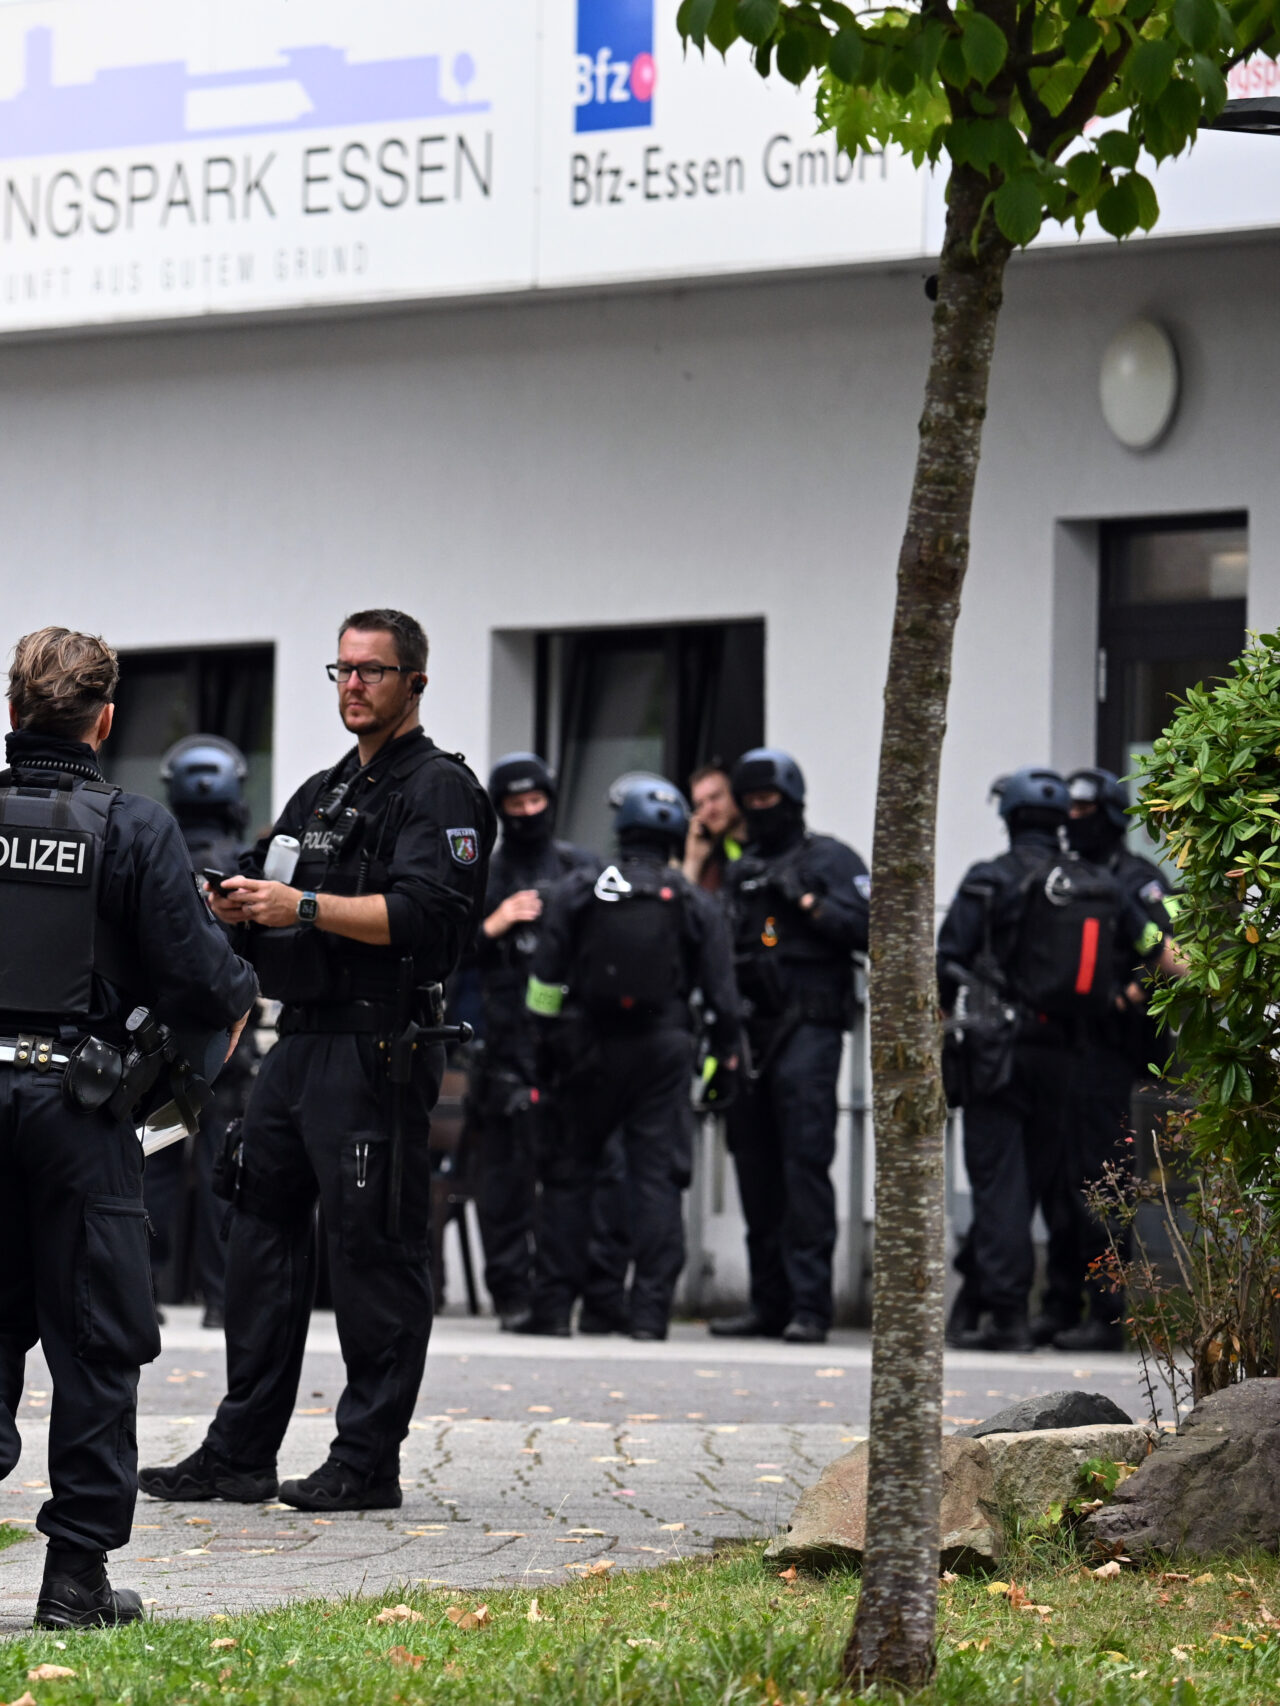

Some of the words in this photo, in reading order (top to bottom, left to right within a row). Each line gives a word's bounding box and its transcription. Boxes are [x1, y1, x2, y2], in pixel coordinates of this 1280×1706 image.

[302, 131, 494, 215] ESSEN
[570, 145, 746, 206] Bfz-Essen
[92, 260, 144, 296] AUS
